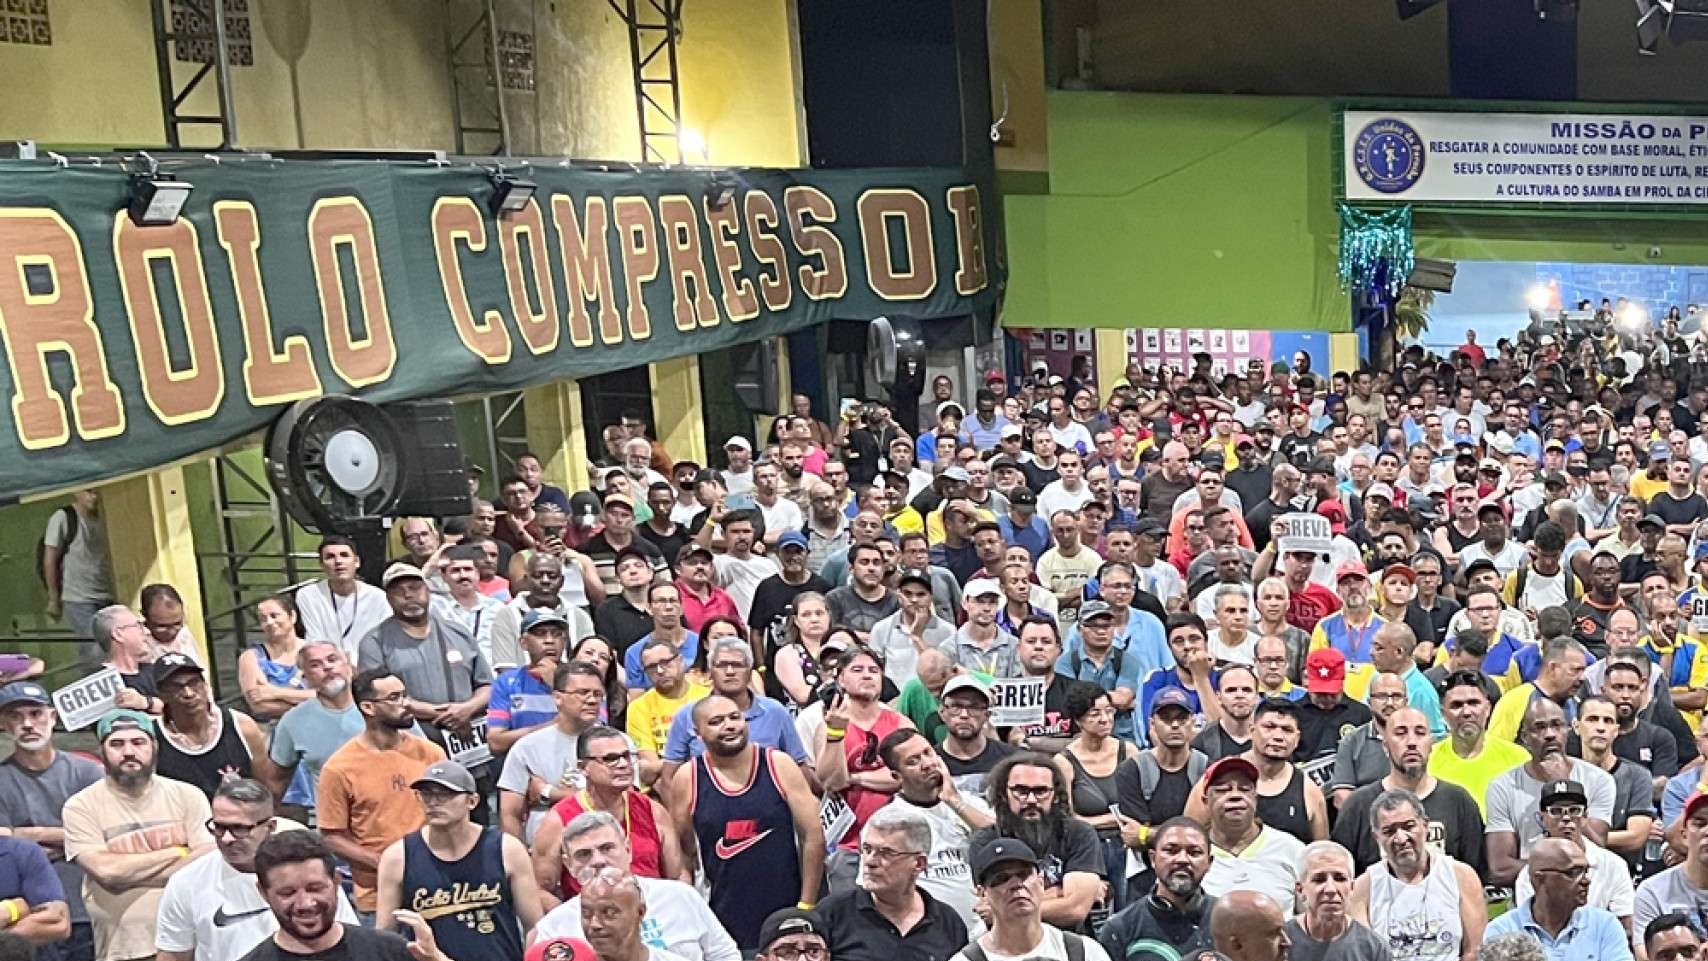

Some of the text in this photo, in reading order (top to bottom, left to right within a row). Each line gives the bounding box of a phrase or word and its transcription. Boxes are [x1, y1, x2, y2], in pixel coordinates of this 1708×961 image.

[1551, 120, 1655, 139] MISSÃO
[1661, 127, 1682, 138] DA
[1430, 141, 1488, 154] RESGATAR
[1492, 143, 1501, 154] A
[1503, 143, 1579, 155] COMUNIDADE
[1582, 144, 1607, 156] COM
[1610, 144, 1640, 156] BASE
[1643, 145, 1685, 158] MORAL,
[1453, 162, 1483, 174] SEUS
[1486, 163, 1572, 176] COMPONENTES
[1575, 165, 1583, 176] O
[1587, 163, 1638, 177] ESPÍRITO
[1642, 166, 1656, 177] DE
[1660, 166, 1691, 179] LUTA,
[1496, 184, 1504, 195] A
[1507, 184, 1559, 196] CULTURA
[1564, 185, 1579, 196] DO
[1582, 185, 1621, 197] SAMBA
[1625, 186, 1641, 197] EM
[1645, 186, 1673, 198] PROL
[1677, 186, 1691, 198] DA
[0, 195, 397, 452] ROLO
[59, 674, 122, 715] GREVE
